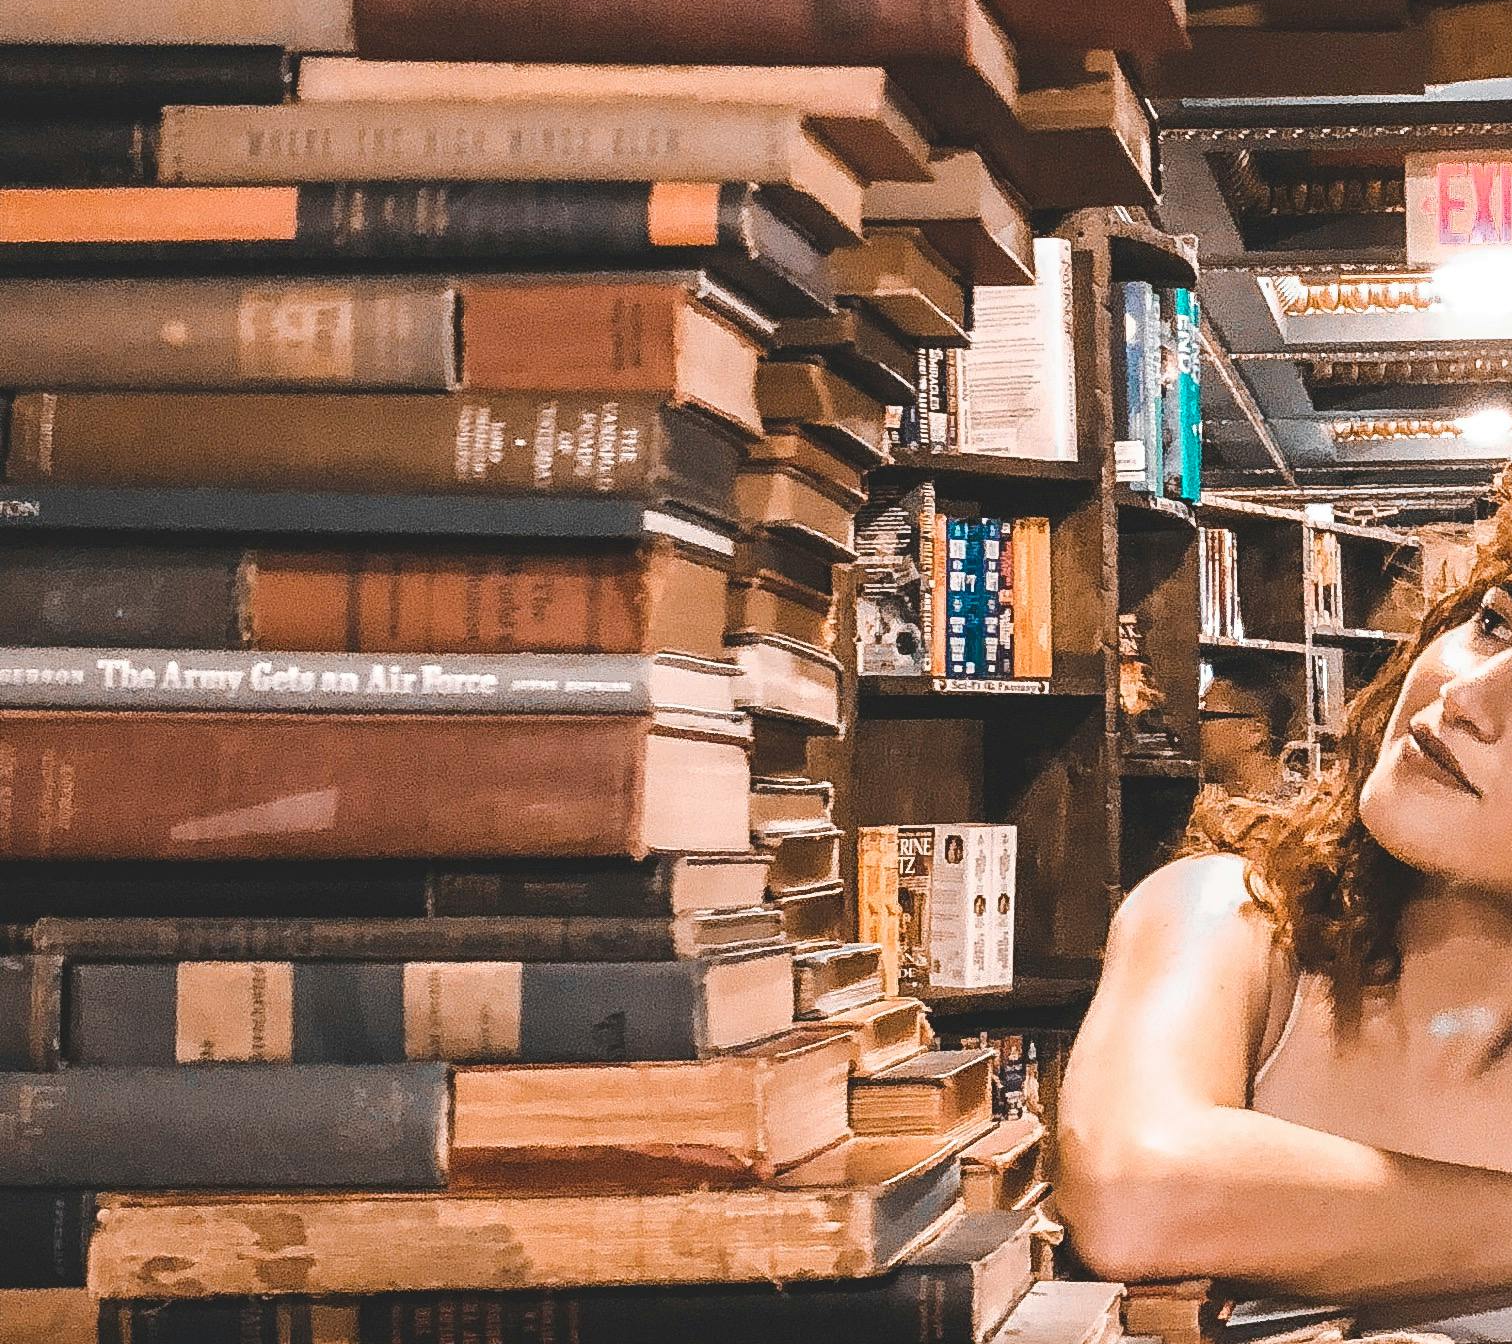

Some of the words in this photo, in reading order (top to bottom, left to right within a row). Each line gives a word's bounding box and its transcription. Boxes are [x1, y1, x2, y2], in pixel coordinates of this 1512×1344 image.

[97, 659, 157, 691] The
[161, 660, 246, 696] Army
[250, 660, 318, 692] Gets
[324, 668, 359, 694] an
[366, 664, 416, 694] Air
[421, 666, 497, 696] Force
